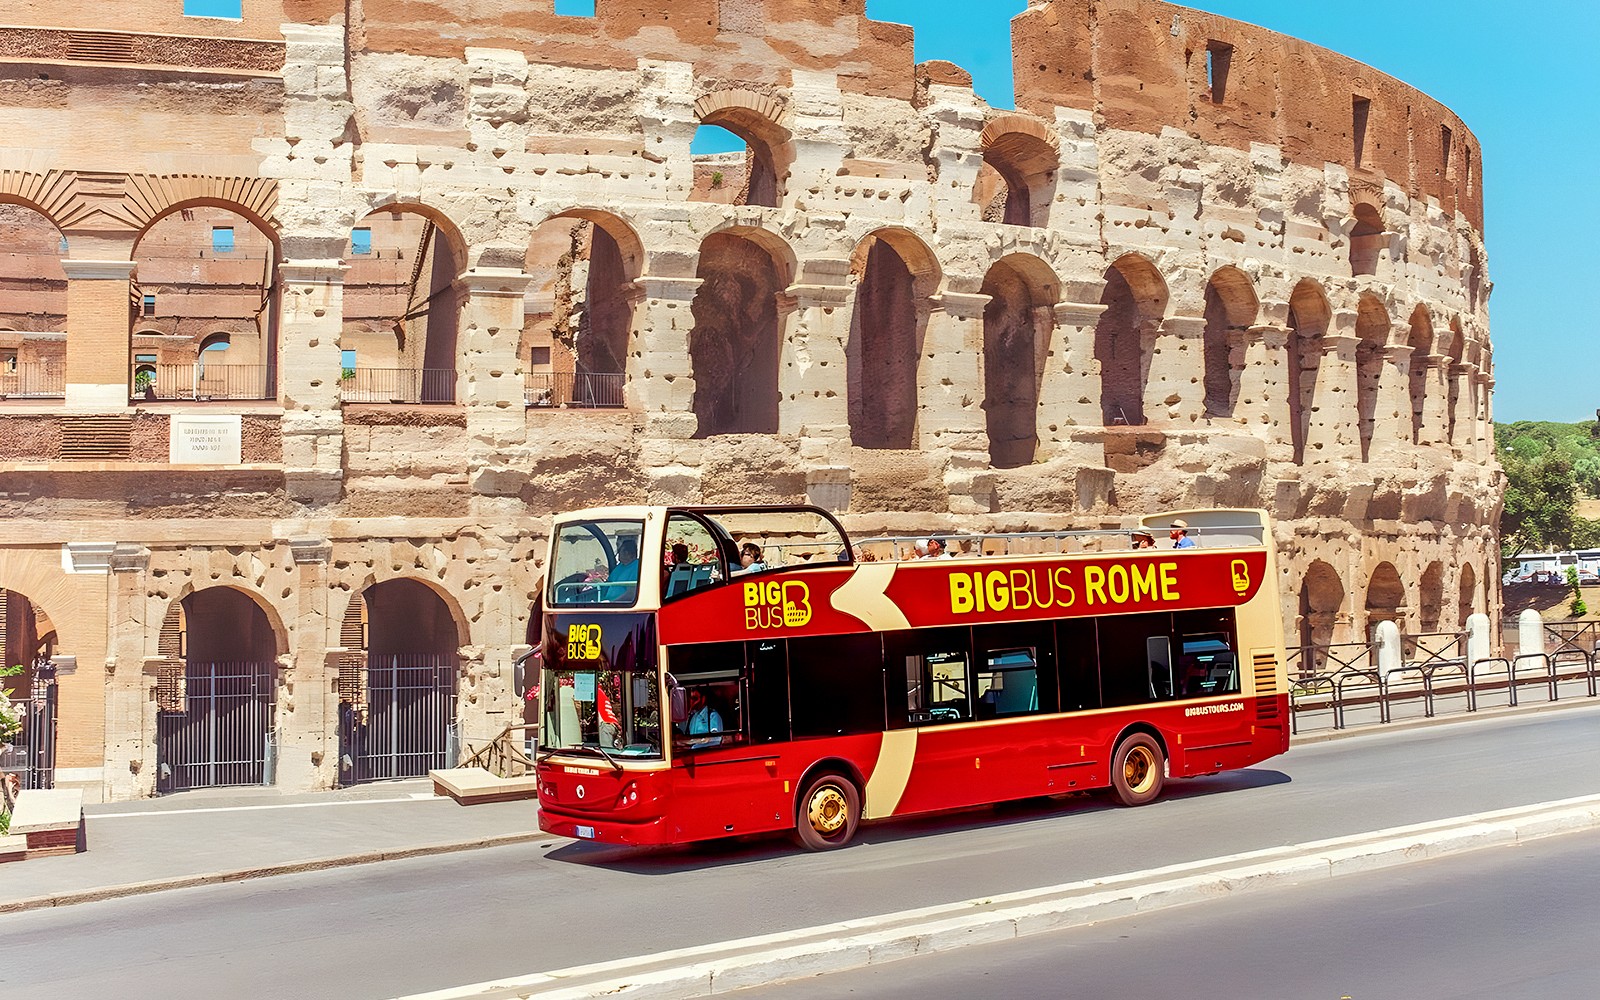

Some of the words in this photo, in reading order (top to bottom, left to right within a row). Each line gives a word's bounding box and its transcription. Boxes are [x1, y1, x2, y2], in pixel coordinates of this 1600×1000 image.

[743, 581, 781, 607] BIG
[949, 567, 1076, 614] BIGBUS
[1084, 562, 1181, 605] ROME
[745, 606, 783, 630] BUS
[568, 624, 587, 643] BIG
[567, 642, 587, 660] BUS
